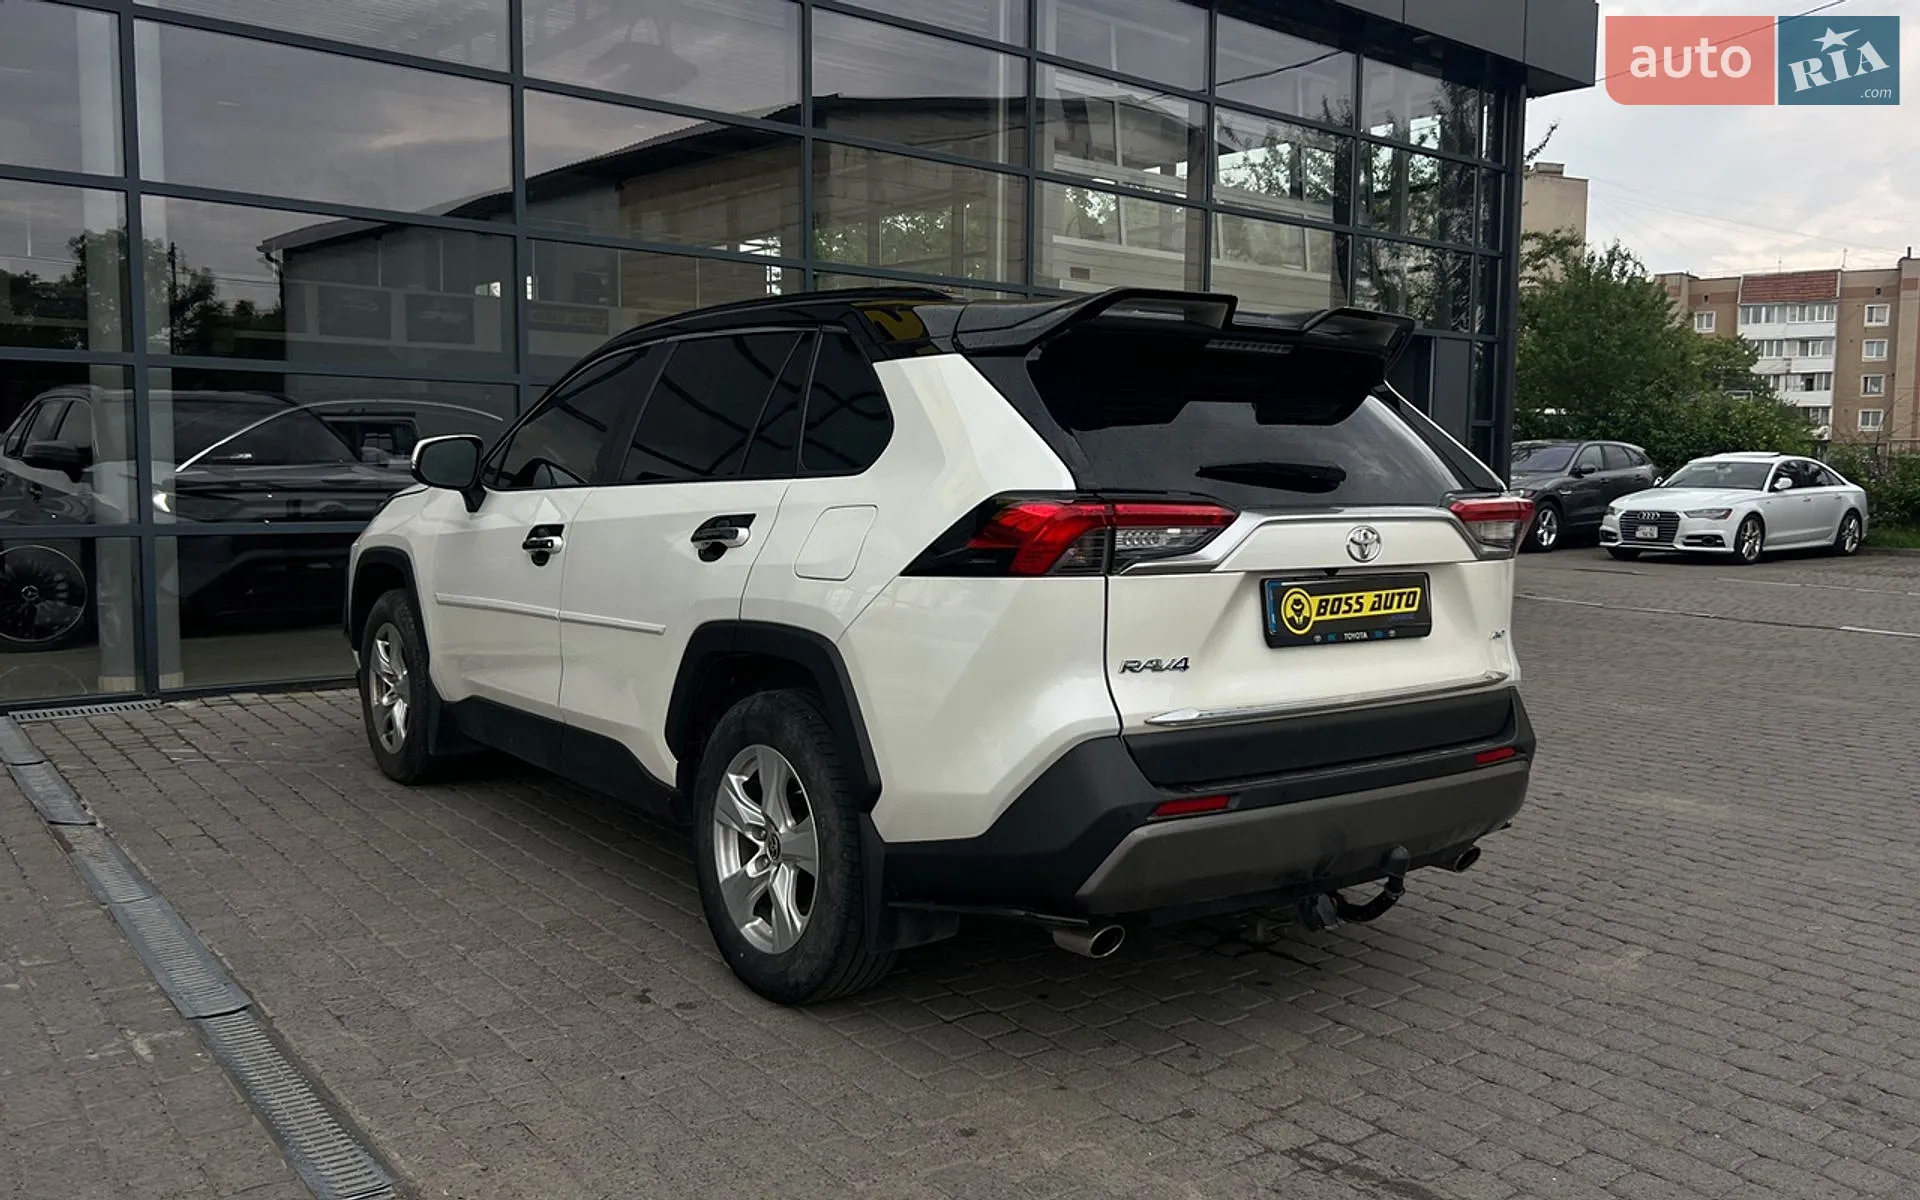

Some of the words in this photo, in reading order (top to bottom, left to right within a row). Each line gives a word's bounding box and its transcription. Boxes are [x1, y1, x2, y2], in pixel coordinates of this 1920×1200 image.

[1315, 595, 1364, 617] BOSS
[1343, 631, 1368, 640] TOYOTA
[1118, 656, 1189, 674] RAV4
